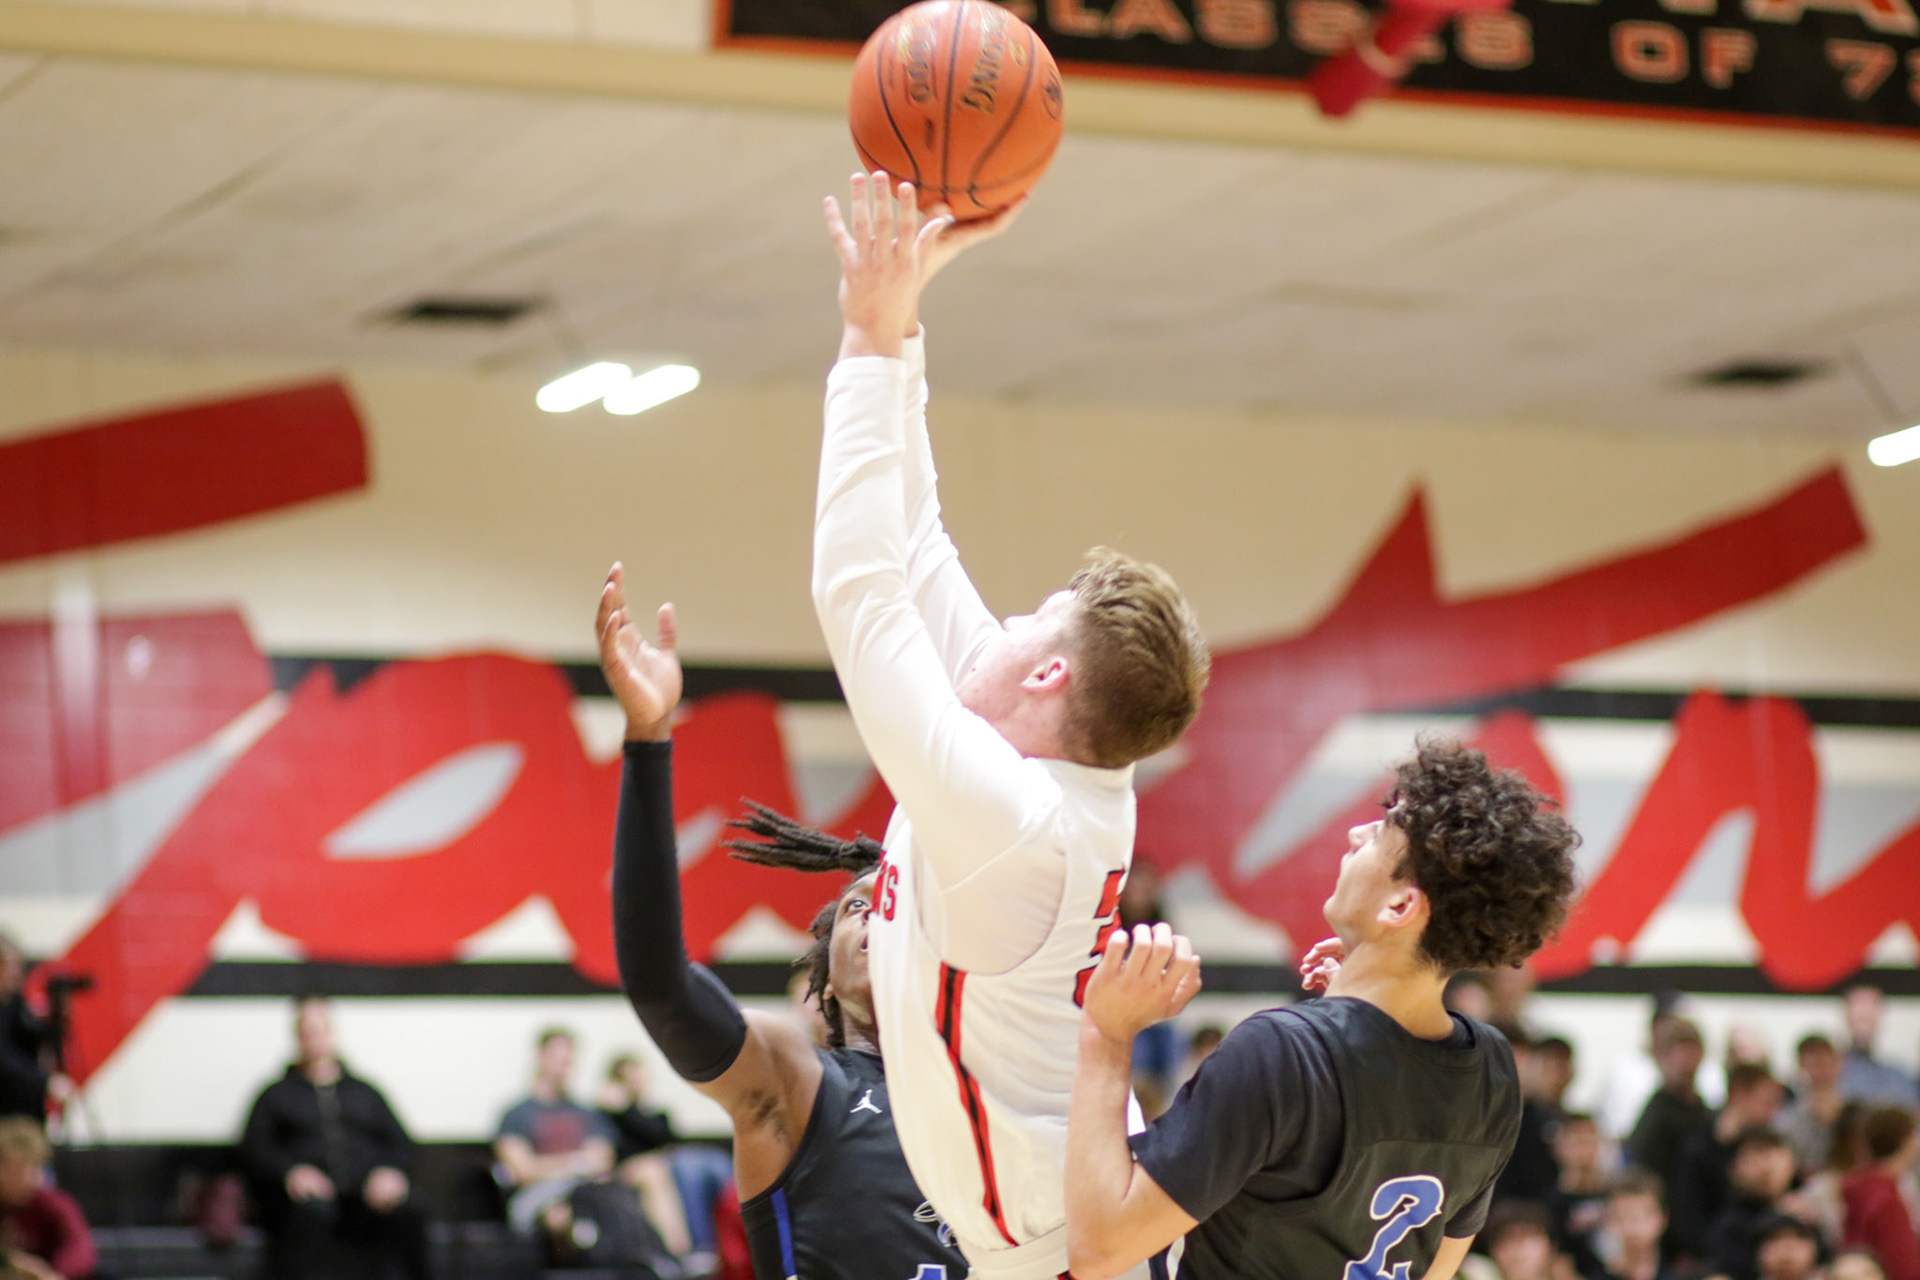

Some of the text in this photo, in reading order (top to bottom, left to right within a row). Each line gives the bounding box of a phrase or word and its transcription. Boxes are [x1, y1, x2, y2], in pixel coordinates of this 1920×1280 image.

[1005, 0, 1535, 71] LASSS
[1609, 19, 1758, 90] OF
[1824, 37, 1920, 107] 7
[1342, 1174, 1445, 1280] 2
